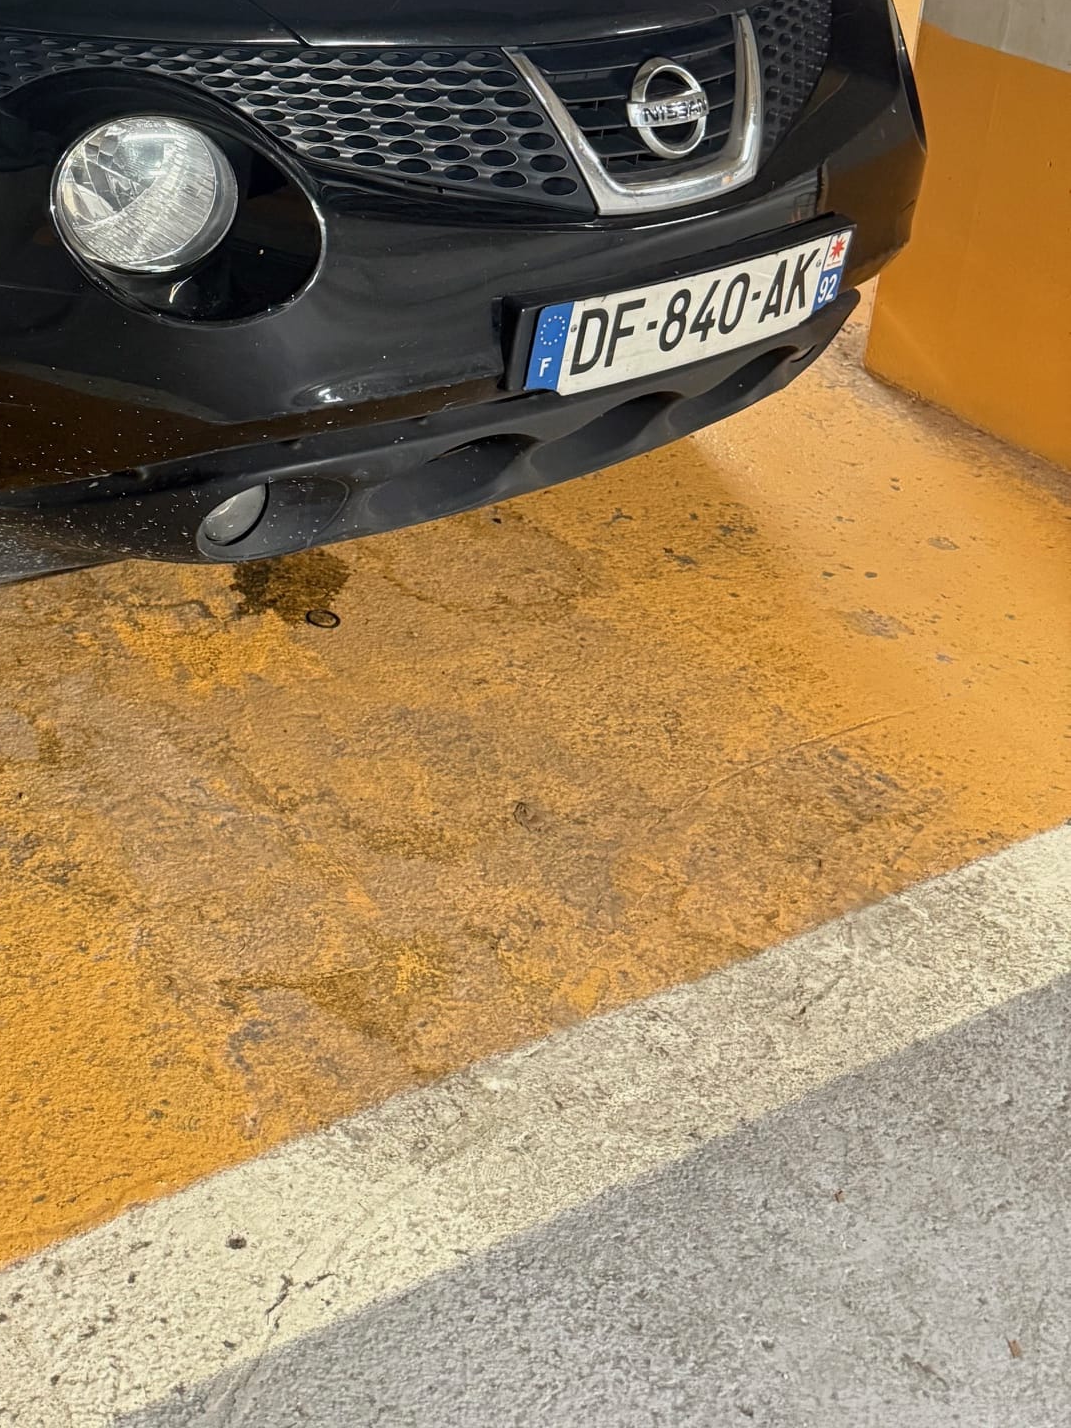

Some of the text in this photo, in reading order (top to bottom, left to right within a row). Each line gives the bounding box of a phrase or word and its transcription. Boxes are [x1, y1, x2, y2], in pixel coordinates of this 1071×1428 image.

[642, 96, 707, 122] NISSAN
[817, 273, 838, 304] 92
[570, 248, 820, 376] DF-840-AK
[538, 356, 553, 378] F
